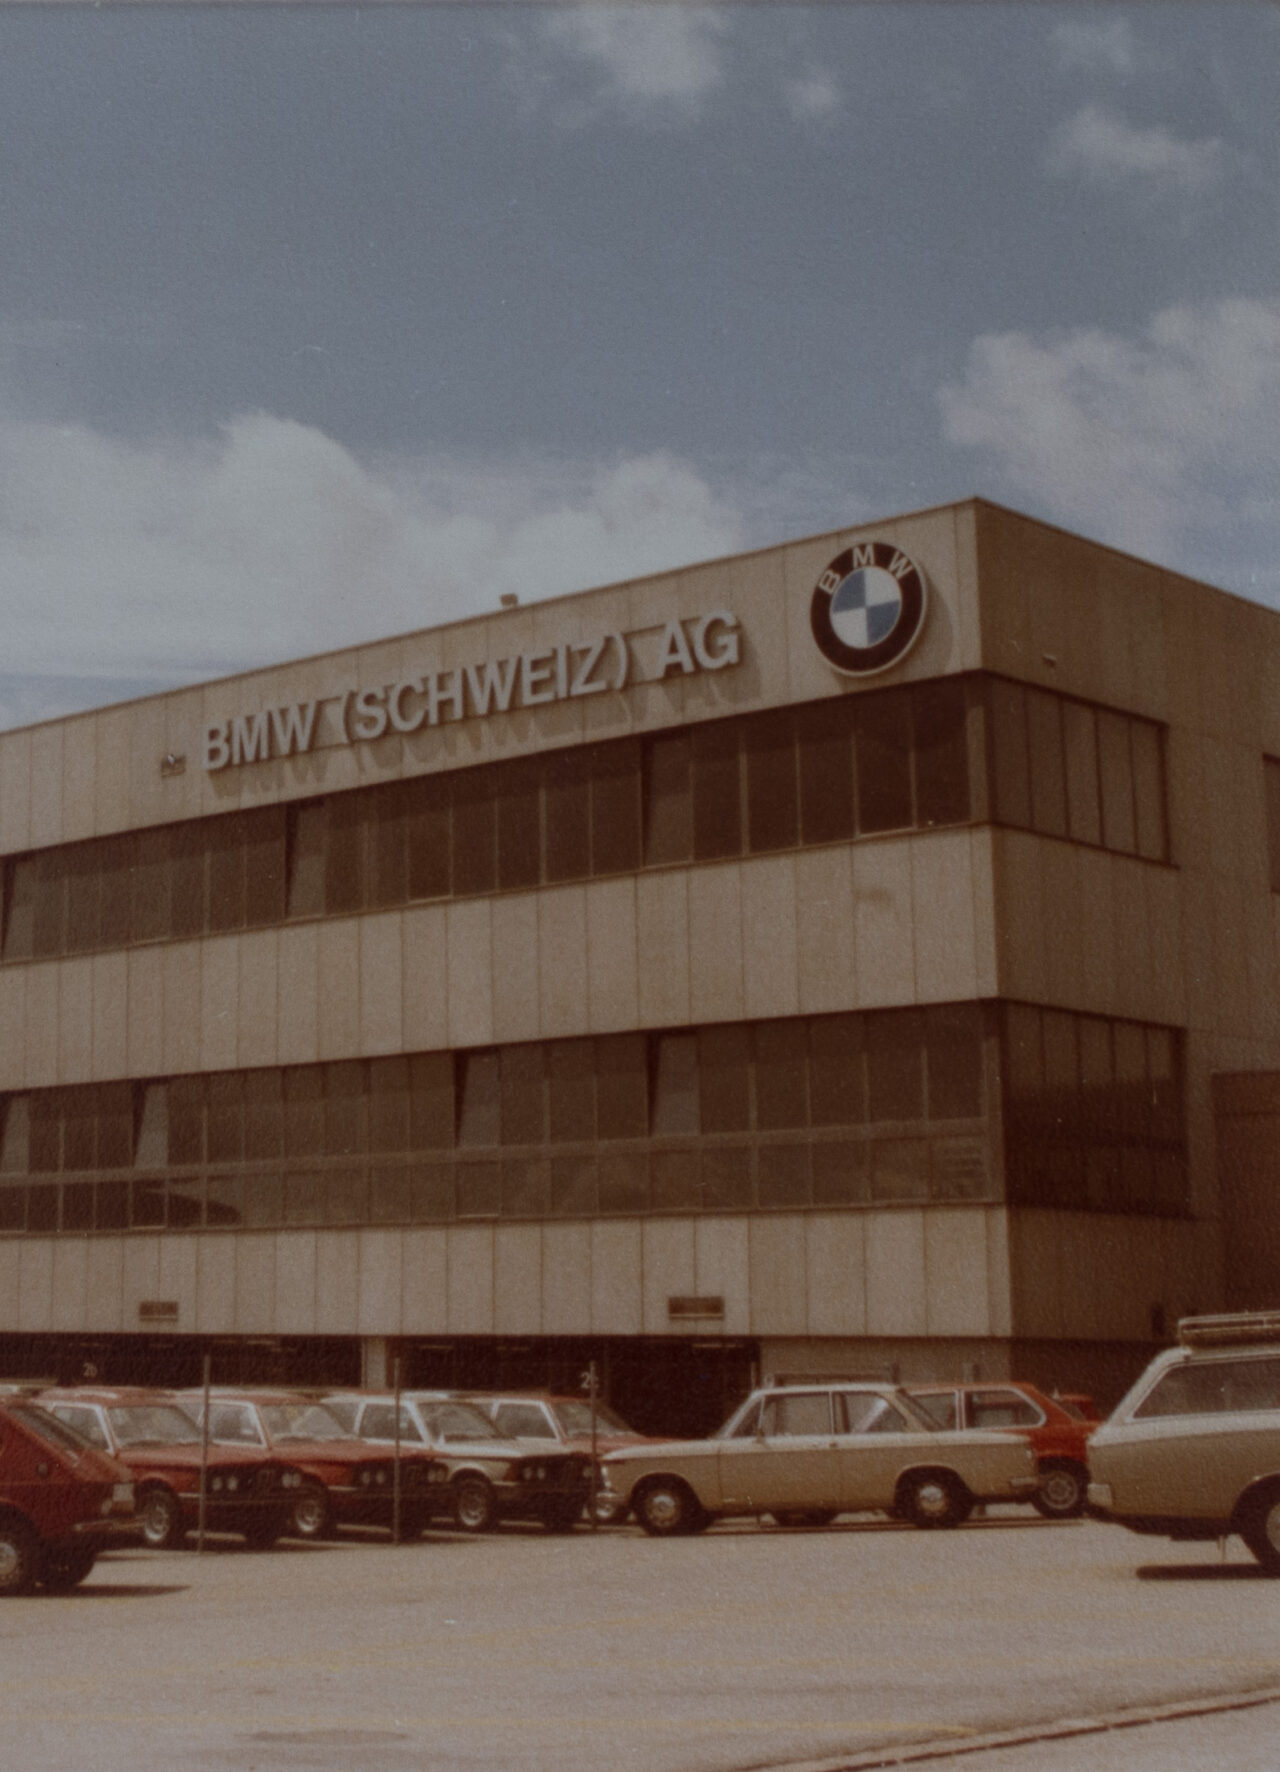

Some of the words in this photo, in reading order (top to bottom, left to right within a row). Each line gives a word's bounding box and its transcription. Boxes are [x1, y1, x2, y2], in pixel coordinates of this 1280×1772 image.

[819, 544, 914, 594] BMW
[202, 699, 318, 770] BMW
[338, 631, 629, 744] (SCHWEIZ)
[654, 609, 740, 679] AG
